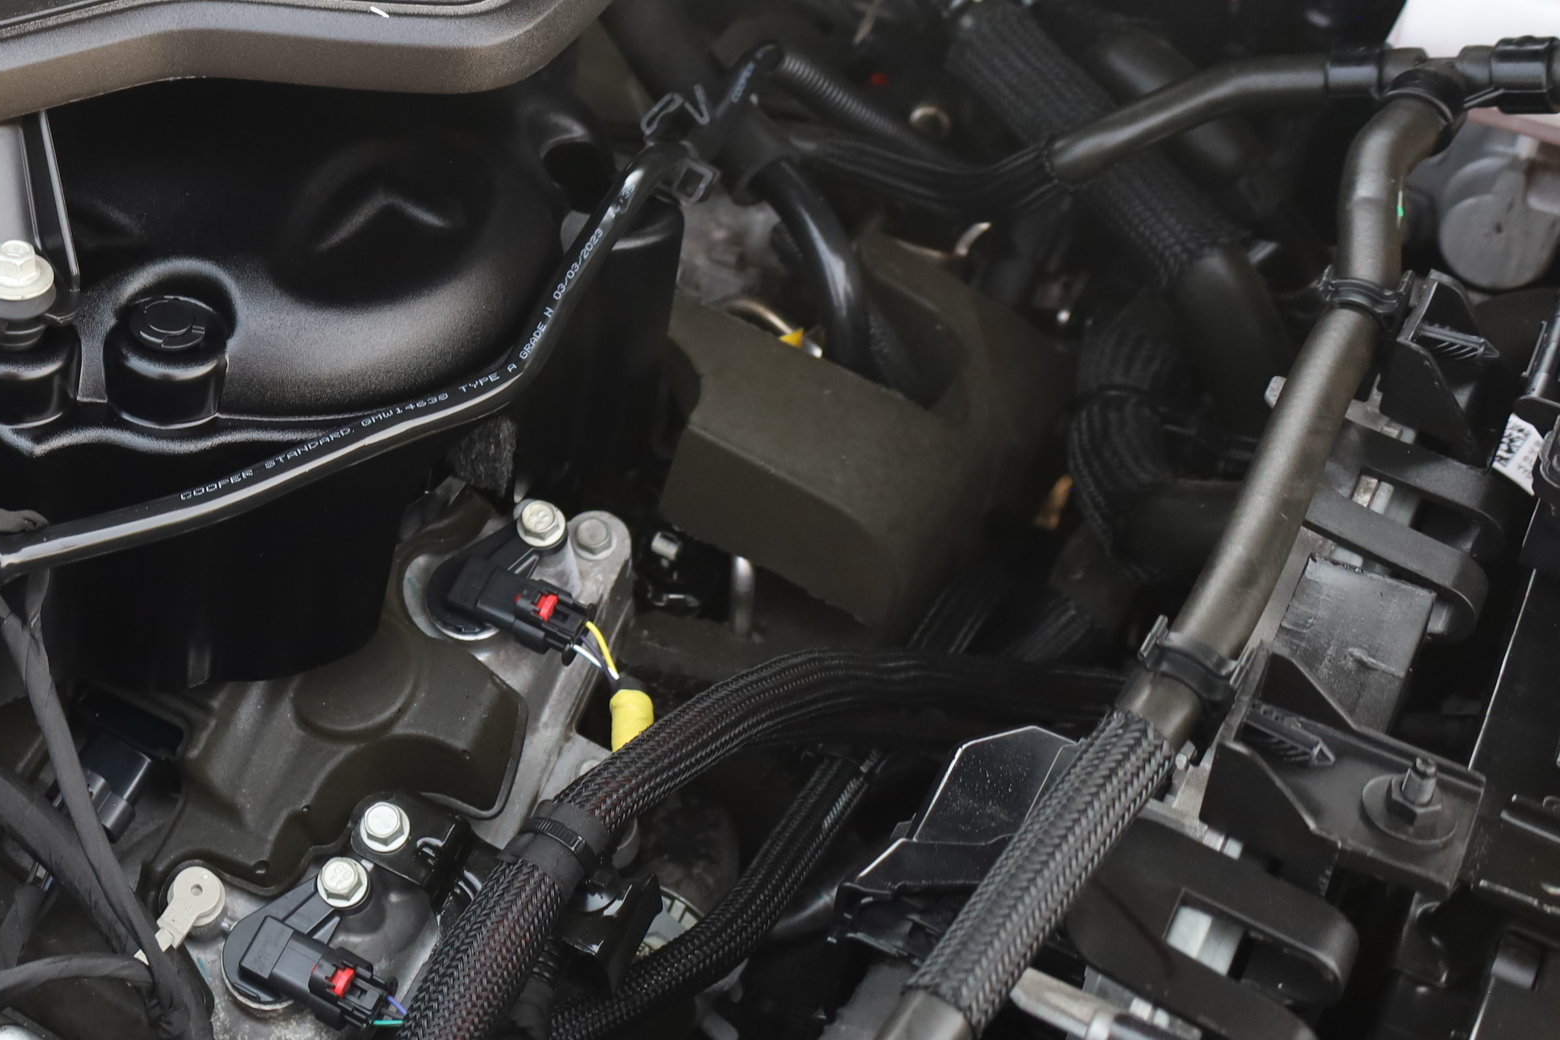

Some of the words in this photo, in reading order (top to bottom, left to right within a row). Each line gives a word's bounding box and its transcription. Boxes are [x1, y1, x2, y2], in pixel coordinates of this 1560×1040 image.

[180, 468, 254, 501] COOPER
[458, 372, 500, 394] TYPE
[507, 363, 517, 373] A
[519, 321, 547, 360] GRADE
[543, 306, 554, 319] N
[552, 227, 604, 301] 03/03/2023
